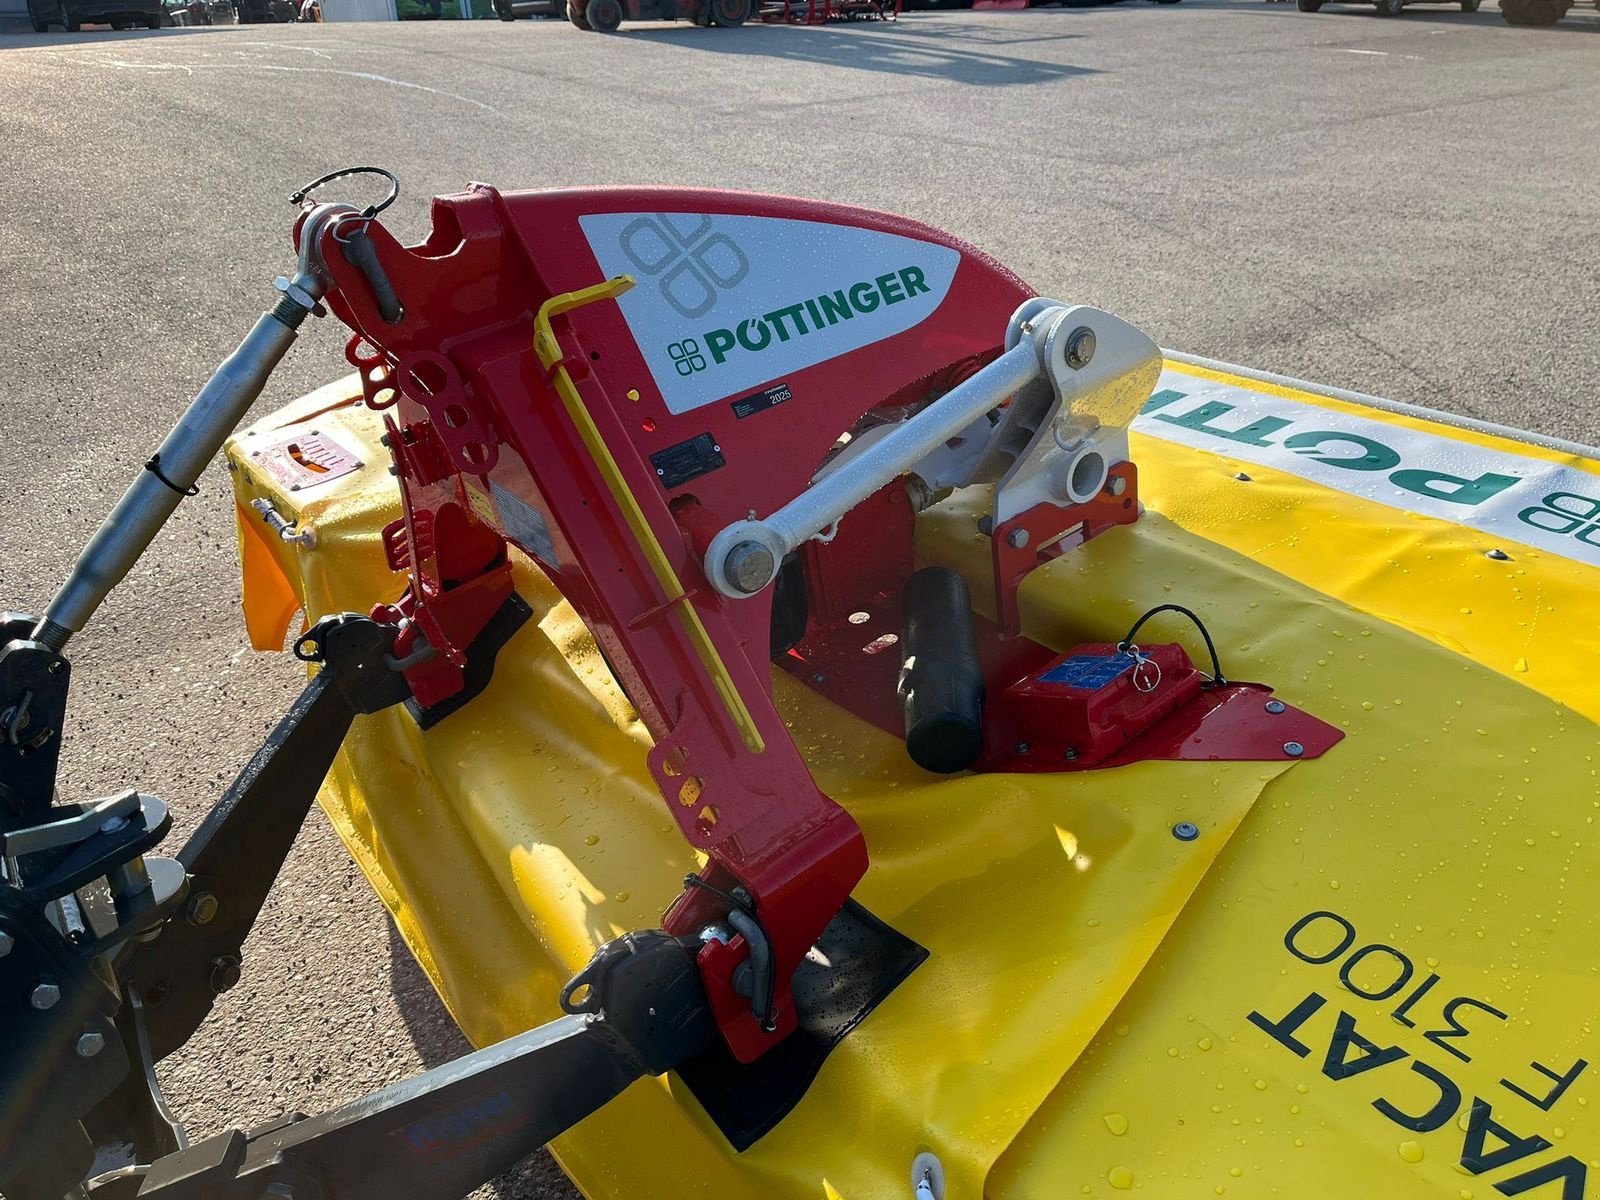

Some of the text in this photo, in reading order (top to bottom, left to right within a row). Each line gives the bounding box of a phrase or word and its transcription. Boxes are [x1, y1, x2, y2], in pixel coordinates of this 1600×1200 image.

[702, 266, 931, 364] PÖTTINGER
[769, 389, 792, 405] 2025
[1284, 911, 1589, 1112] F 3100
